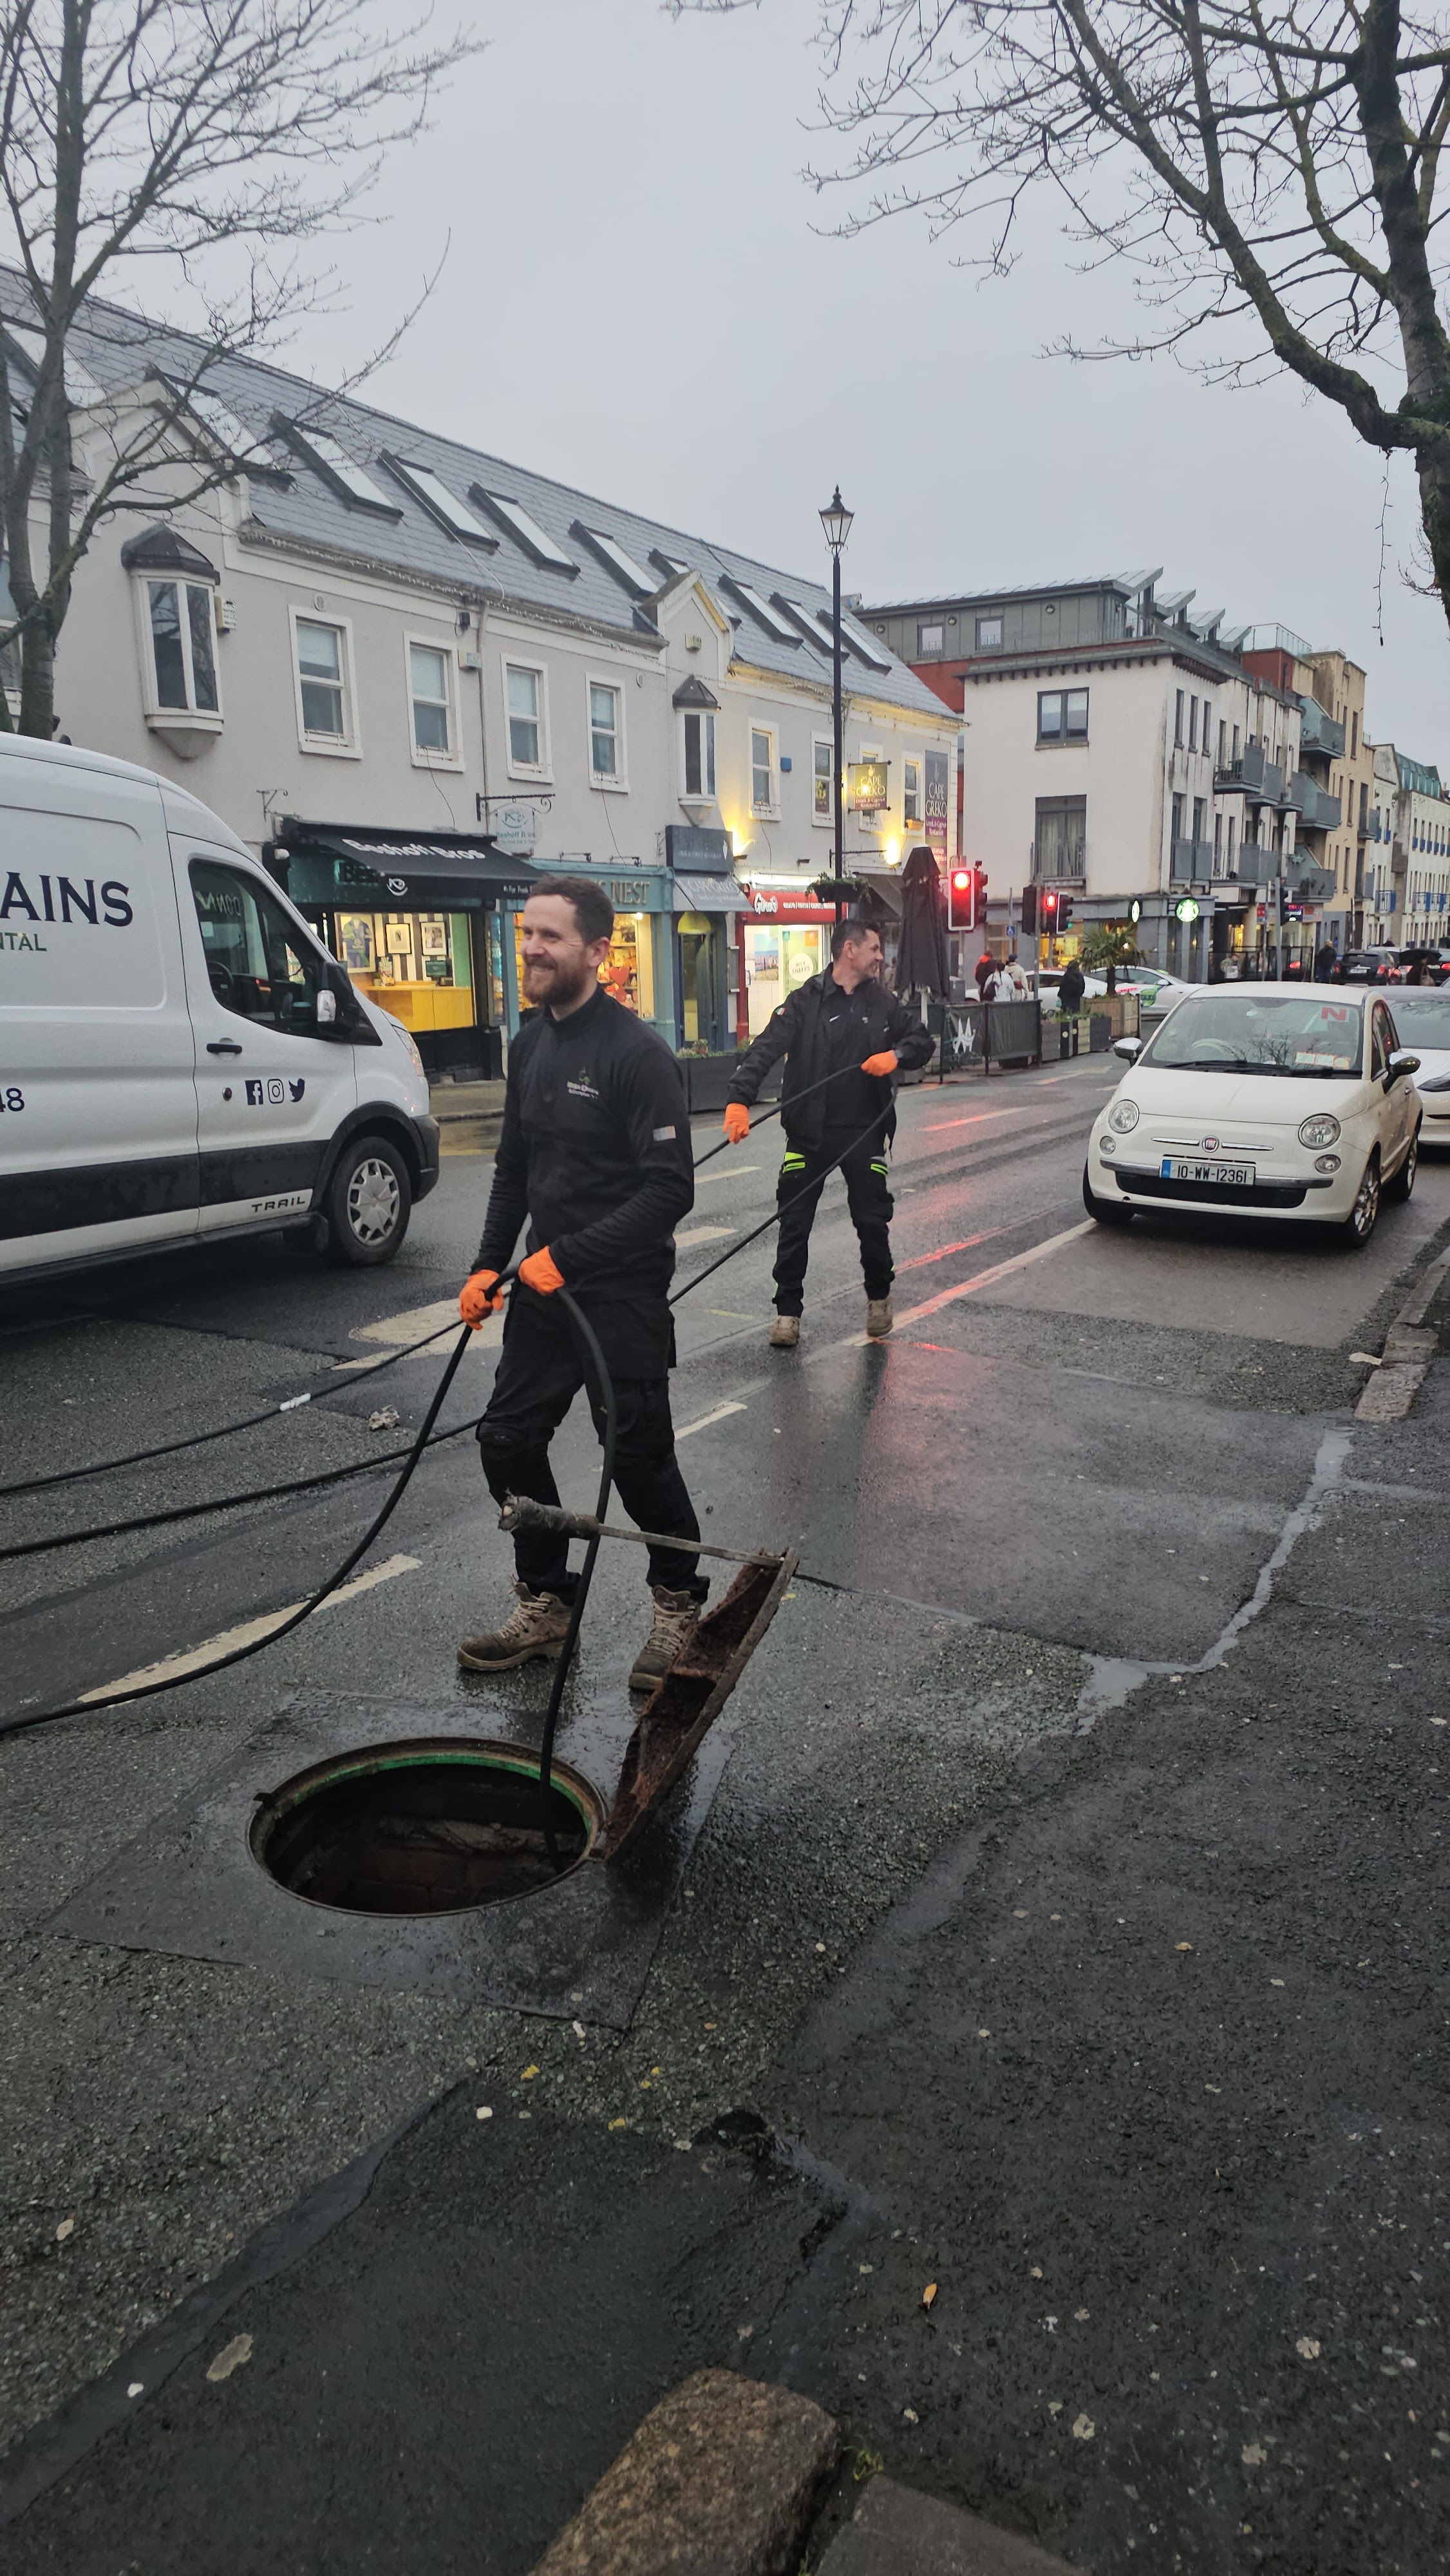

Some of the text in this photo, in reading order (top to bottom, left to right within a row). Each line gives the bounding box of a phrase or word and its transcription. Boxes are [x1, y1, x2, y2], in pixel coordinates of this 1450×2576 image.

[860, 775, 881, 786] CAPE
[856, 785, 885, 797] GREKO
[928, 782, 945, 800] CAPE
[926, 800, 947, 818] GREKO
[342, 838, 486, 860] Beshoff Bros
[0, 871, 133, 927] AINS
[611, 880, 650, 904] NEST
[1321, 1007, 1347, 1021] N
[1178, 1166, 1247, 1184] 10-WW-12361
[252, 1196, 306, 1213] TRAIL
